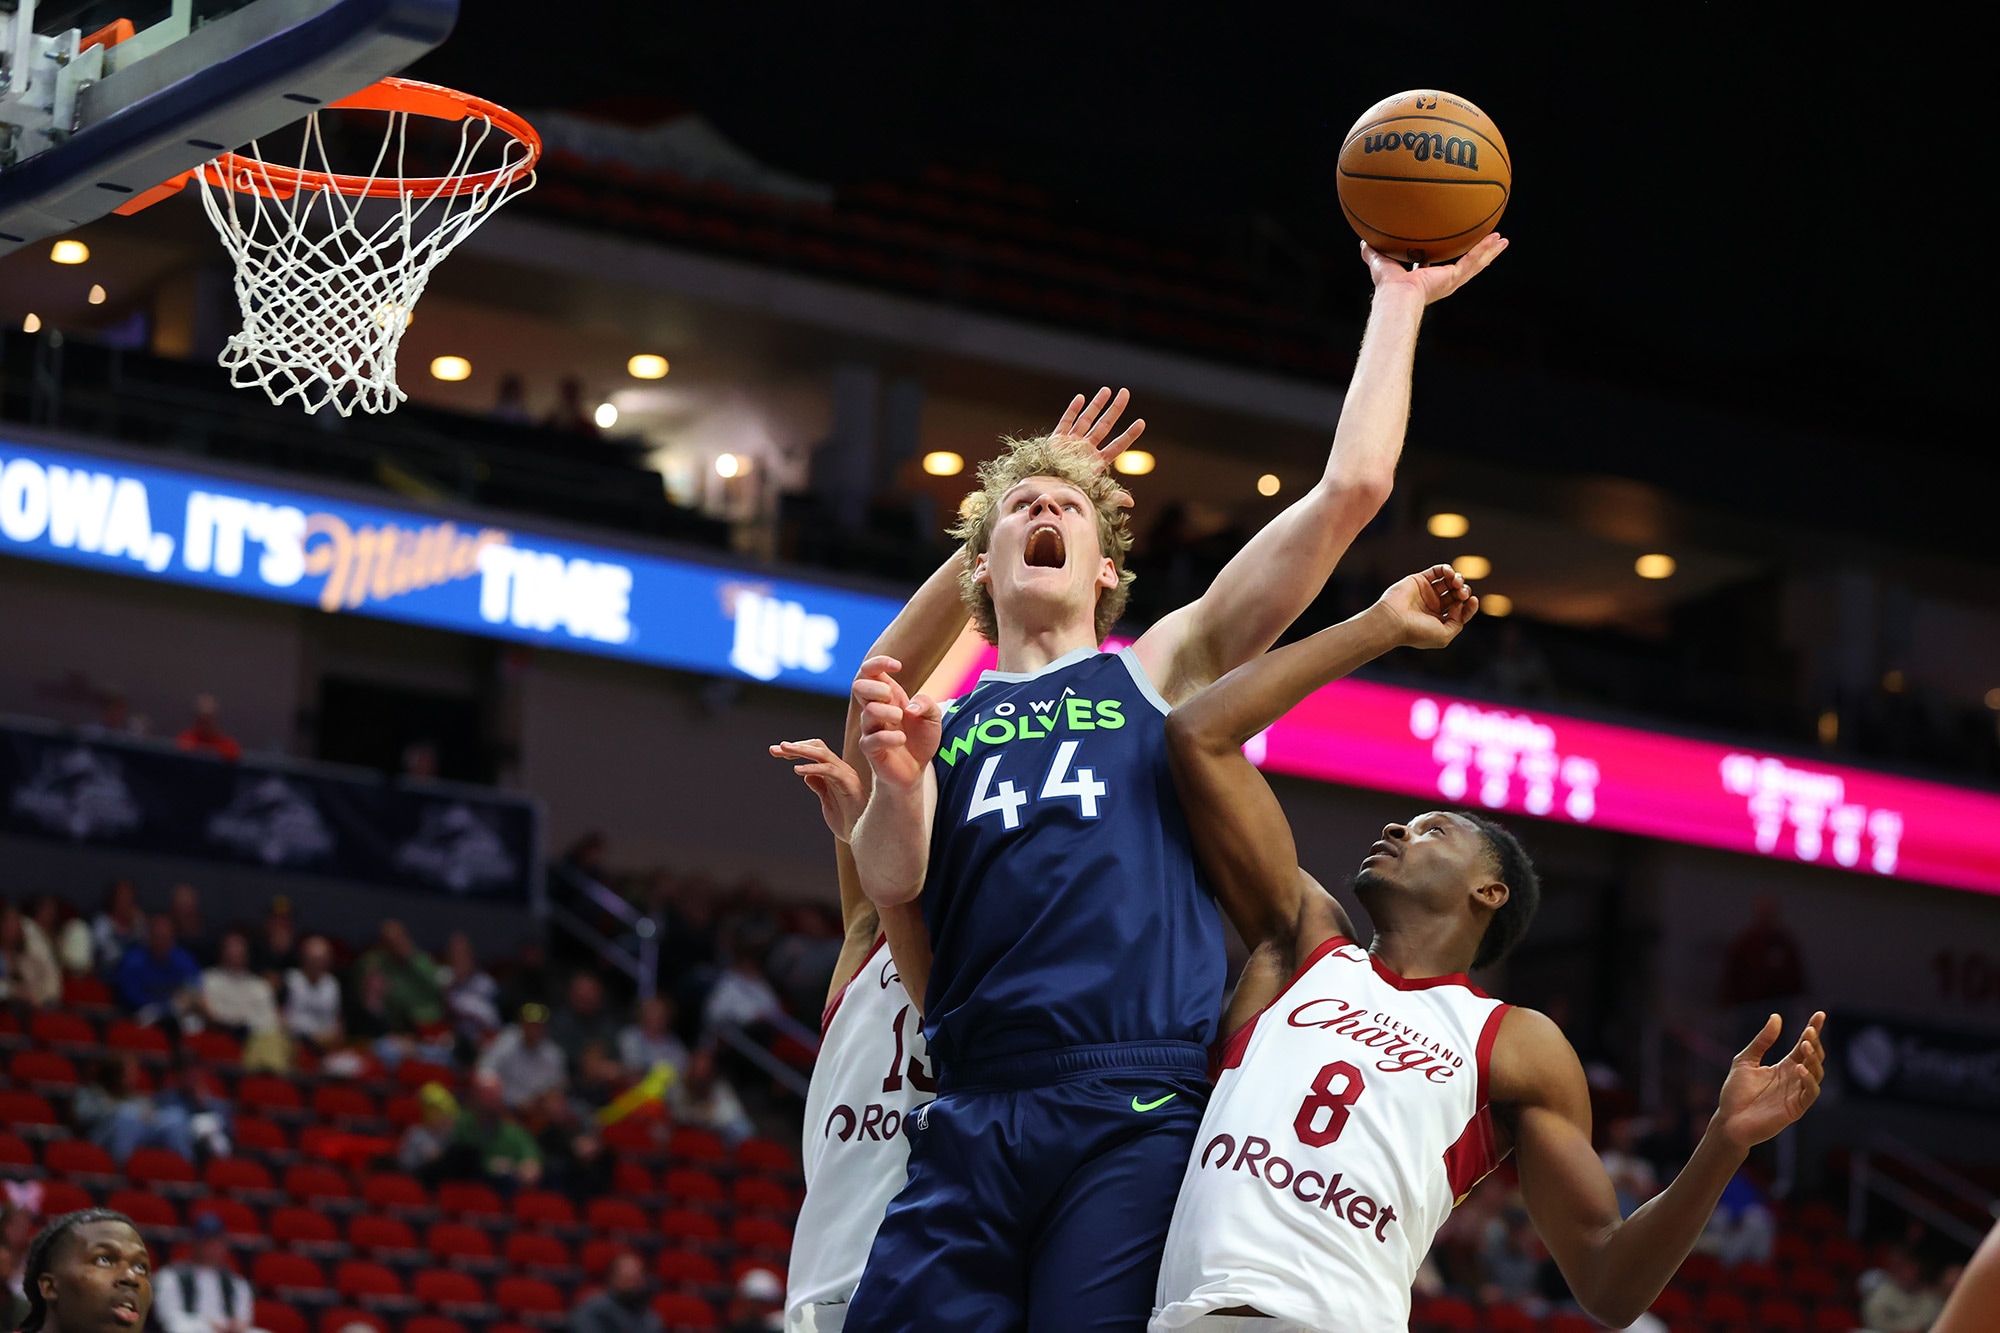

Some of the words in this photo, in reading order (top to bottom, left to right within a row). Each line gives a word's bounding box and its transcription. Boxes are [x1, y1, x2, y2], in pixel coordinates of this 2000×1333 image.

[1364, 130, 1479, 171] Wilson
[0, 457, 175, 573] OWA,
[183, 490, 306, 587] IT'S
[938, 697, 1126, 767] WOLVES
[973, 686, 1076, 726] IOWA
[965, 738, 1109, 832] 44
[1287, 998, 1455, 1084] Charge
[1373, 1012, 1464, 1068] CLEVELAND
[1293, 1060, 1365, 1148] 8
[1232, 1135, 1397, 1243] Rocket
